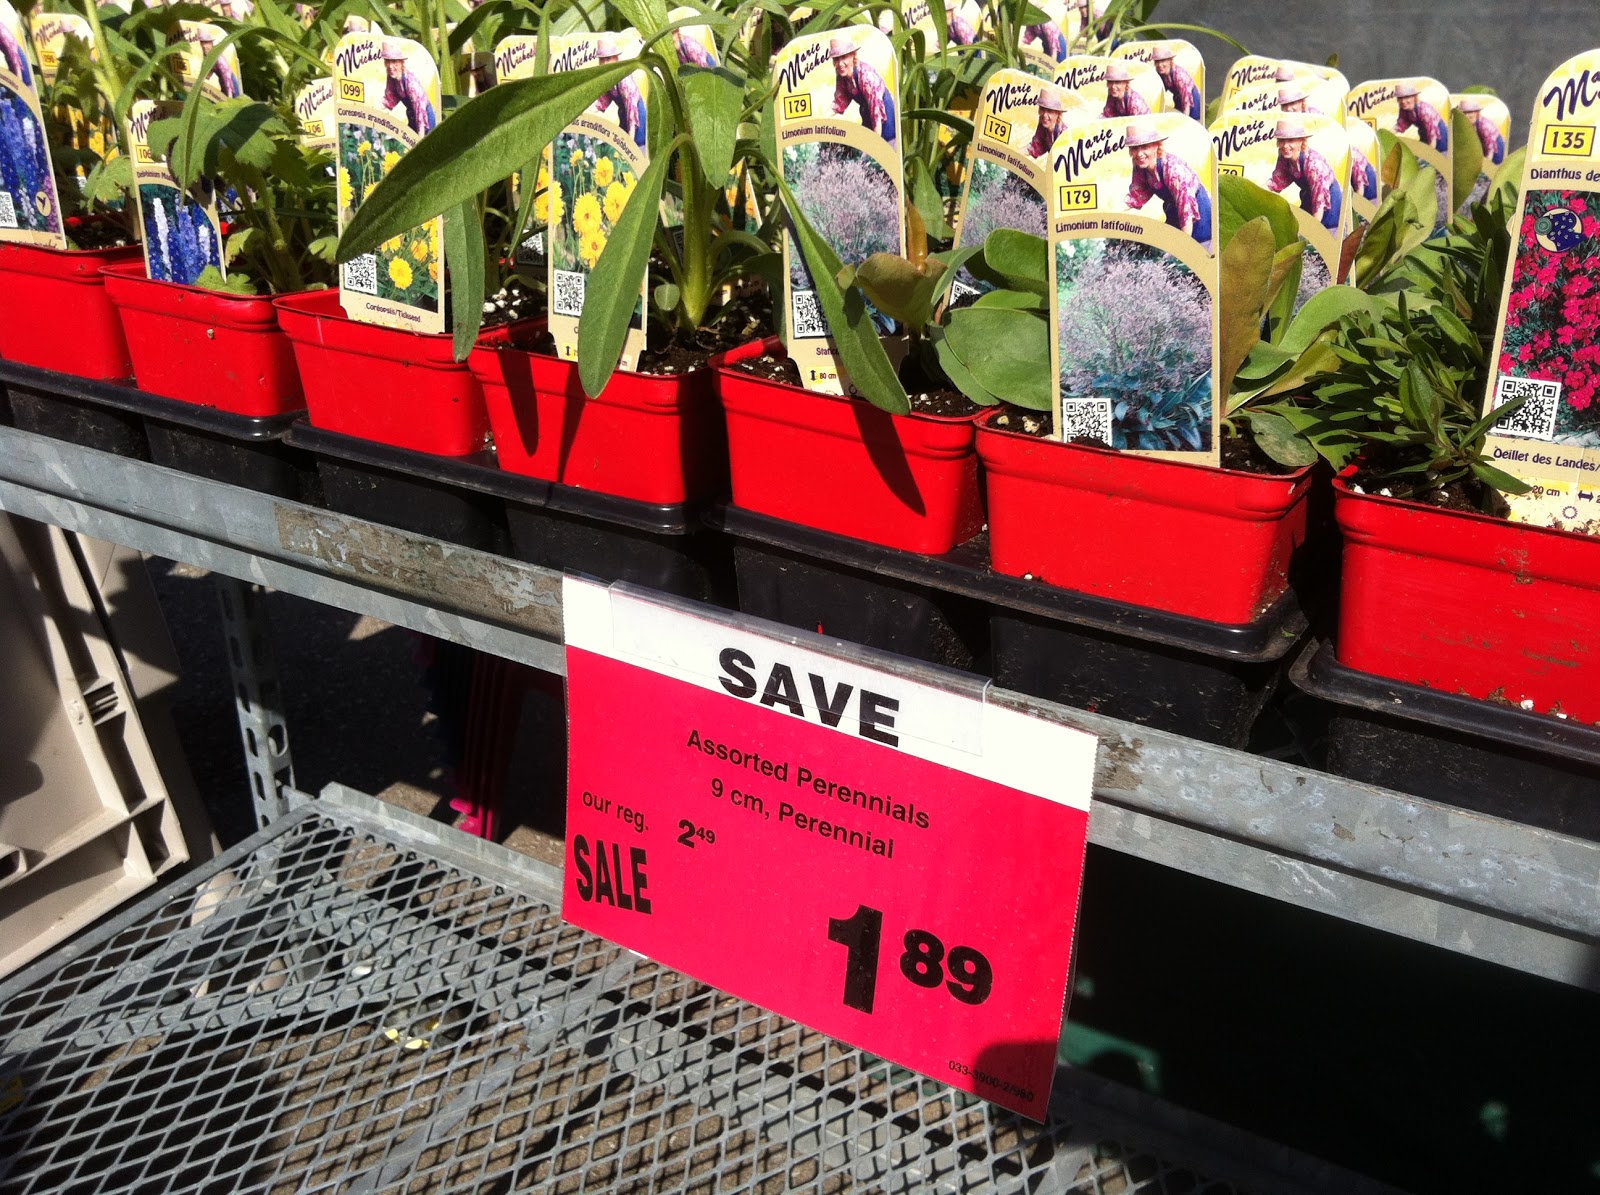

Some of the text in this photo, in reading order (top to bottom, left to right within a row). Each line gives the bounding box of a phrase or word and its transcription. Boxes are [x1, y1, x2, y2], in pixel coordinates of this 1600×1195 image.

[337, 40, 374, 77] Marie
[337, 46, 382, 77] Michel
[496, 42, 526, 77] Marie
[554, 40, 590, 72] Marie
[554, 47, 598, 72] Michel
[780, 43, 821, 93] Marie
[780, 48, 832, 93] Michel
[343, 83, 361, 97] 099
[1055, 64, 1097, 90] Marie
[1055, 69, 1106, 90] Michel
[1232, 64, 1269, 88] Marie
[1232, 68, 1276, 88] Michel
[788, 99, 807, 114] 179
[986, 83, 1032, 115] Marie
[986, 88, 1041, 115] Michel
[1349, 87, 1387, 117] Marie
[1349, 91, 1397, 117] Michel
[782, 125, 846, 140] Limonium latifolium
[988, 120, 1007, 138] 179
[1213, 120, 1264, 161] Marie
[1213, 127, 1275, 161] Michel
[1552, 130, 1585, 149] 135
[977, 143, 1035, 179] Limonium latifolium
[1054, 129, 1113, 182] Marie
[1054, 135, 1126, 182] Michel
[1530, 168, 1582, 181] Dianthus
[1066, 190, 1091, 205] 179
[1055, 219, 1144, 236] Limonium latifolium
[1493, 447, 1530, 462] Oeillet
[1532, 453, 1552, 465] des
[1546, 488, 1560, 497] cm
[718, 647, 900, 748] SAVE
[687, 729, 930, 829] Assorted Perennials
[582, 791, 612, 814] our
[616, 804, 649, 833] reg.
[711, 778, 894, 859] 9 cm, Perennial
[573, 834, 652, 915] SALE
